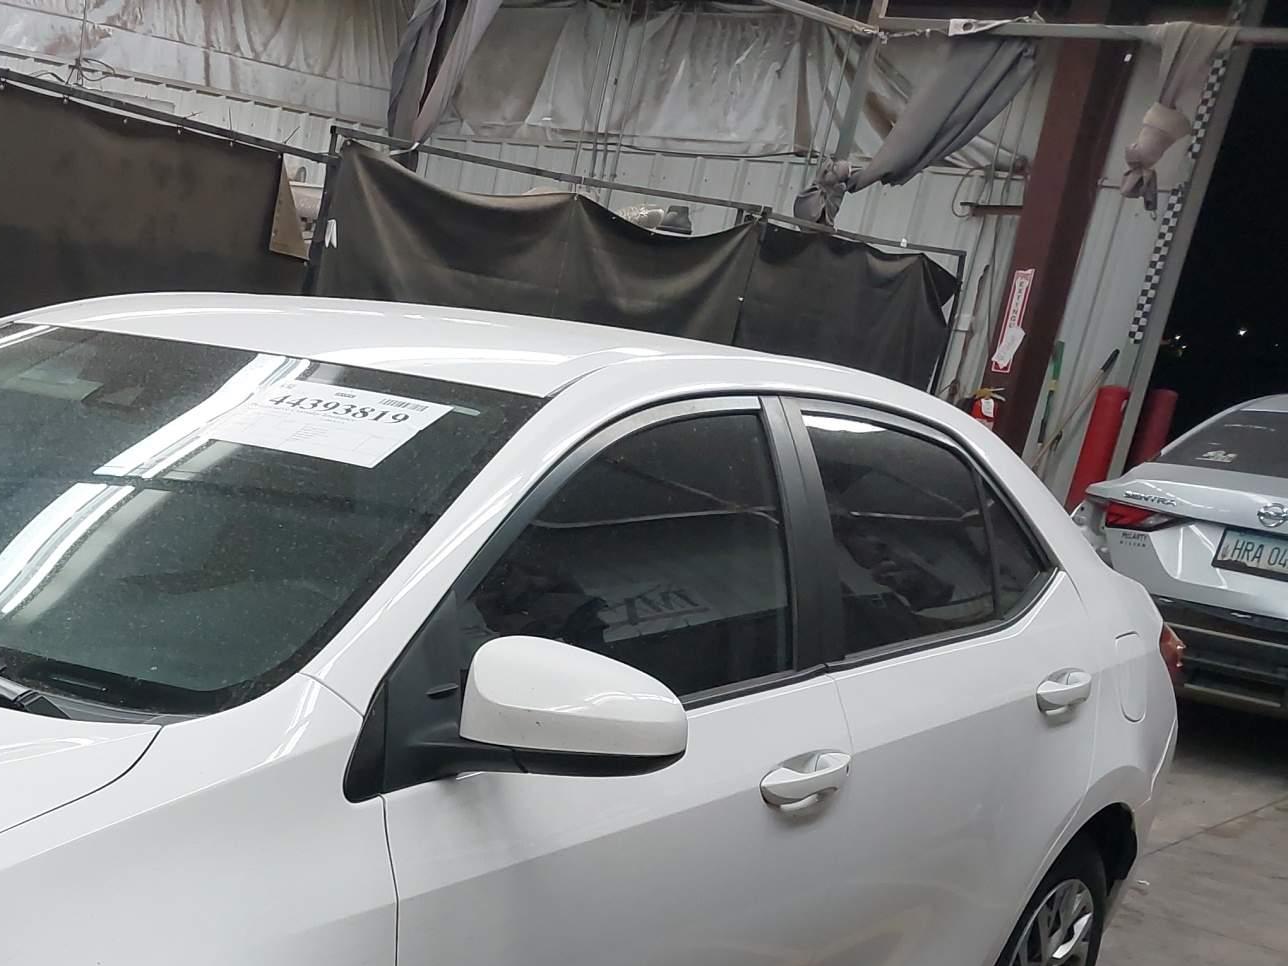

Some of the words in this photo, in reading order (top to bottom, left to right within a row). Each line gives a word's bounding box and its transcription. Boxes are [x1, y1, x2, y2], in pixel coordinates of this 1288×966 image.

[268, 394, 410, 424] 44393819
[1123, 491, 1177, 507] SENTRA
[1231, 539, 1265, 563] HRA
